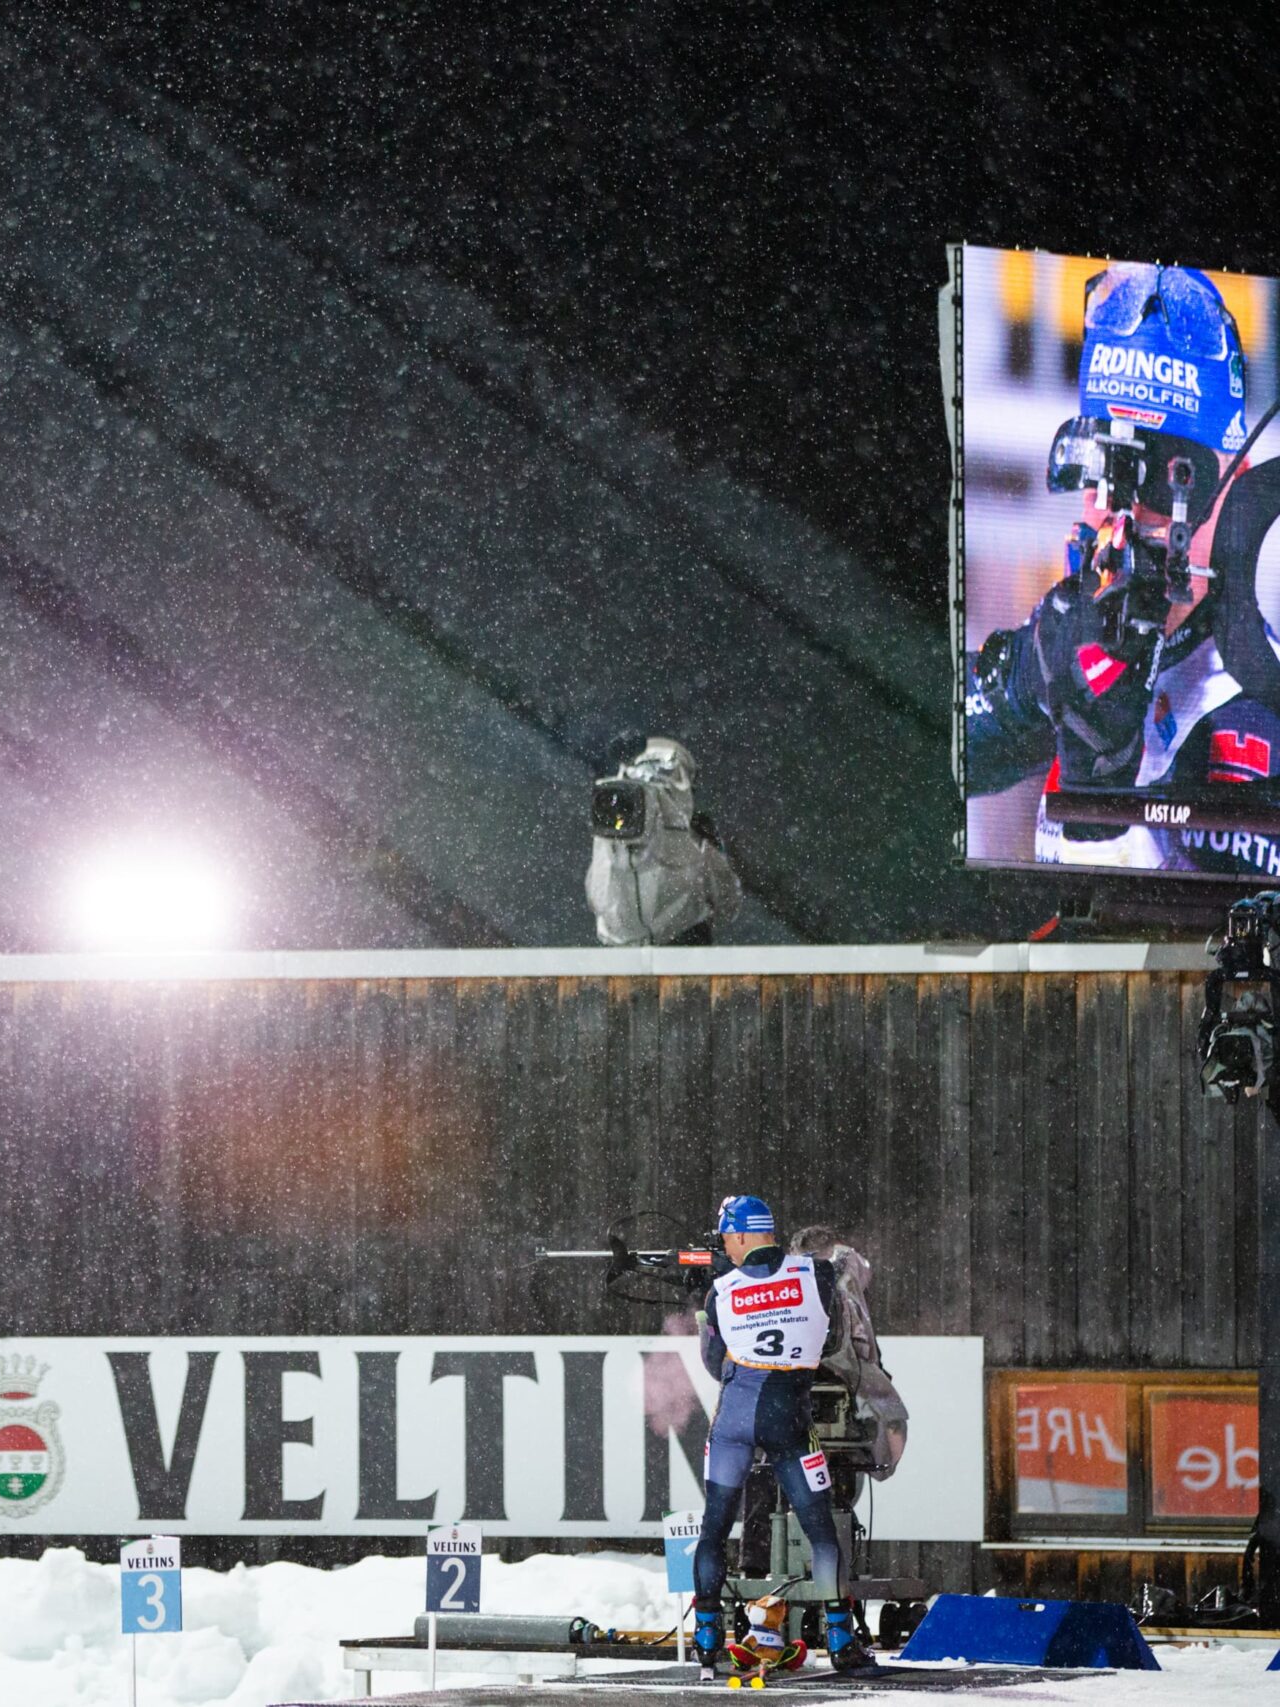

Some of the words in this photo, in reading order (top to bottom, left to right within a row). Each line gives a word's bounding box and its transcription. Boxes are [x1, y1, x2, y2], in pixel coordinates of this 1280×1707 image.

[1089, 343, 1202, 397] ERDINGER
[1086, 377, 1199, 413] ALKOHOLFREI
[1144, 803, 1169, 823] LAST
[1170, 805, 1191, 824] LAP
[734, 1286, 800, 1308] bett1.de
[731, 1319, 778, 1332] meistgekaufte
[779, 1315, 809, 1324] Matratze
[746, 1308, 792, 1321] Deutschlands
[753, 1329, 785, 1357] 3
[790, 1347, 803, 1359] 2
[104, 1351, 718, 1521] VELTIN
[815, 1471, 827, 1485] 3
[670, 1524, 702, 1537] VELTI
[433, 1541, 477, 1553] VELTINS
[127, 1556, 175, 1569] VELTINS
[440, 1557, 466, 1609] 2
[137, 1573, 166, 1630] 3
